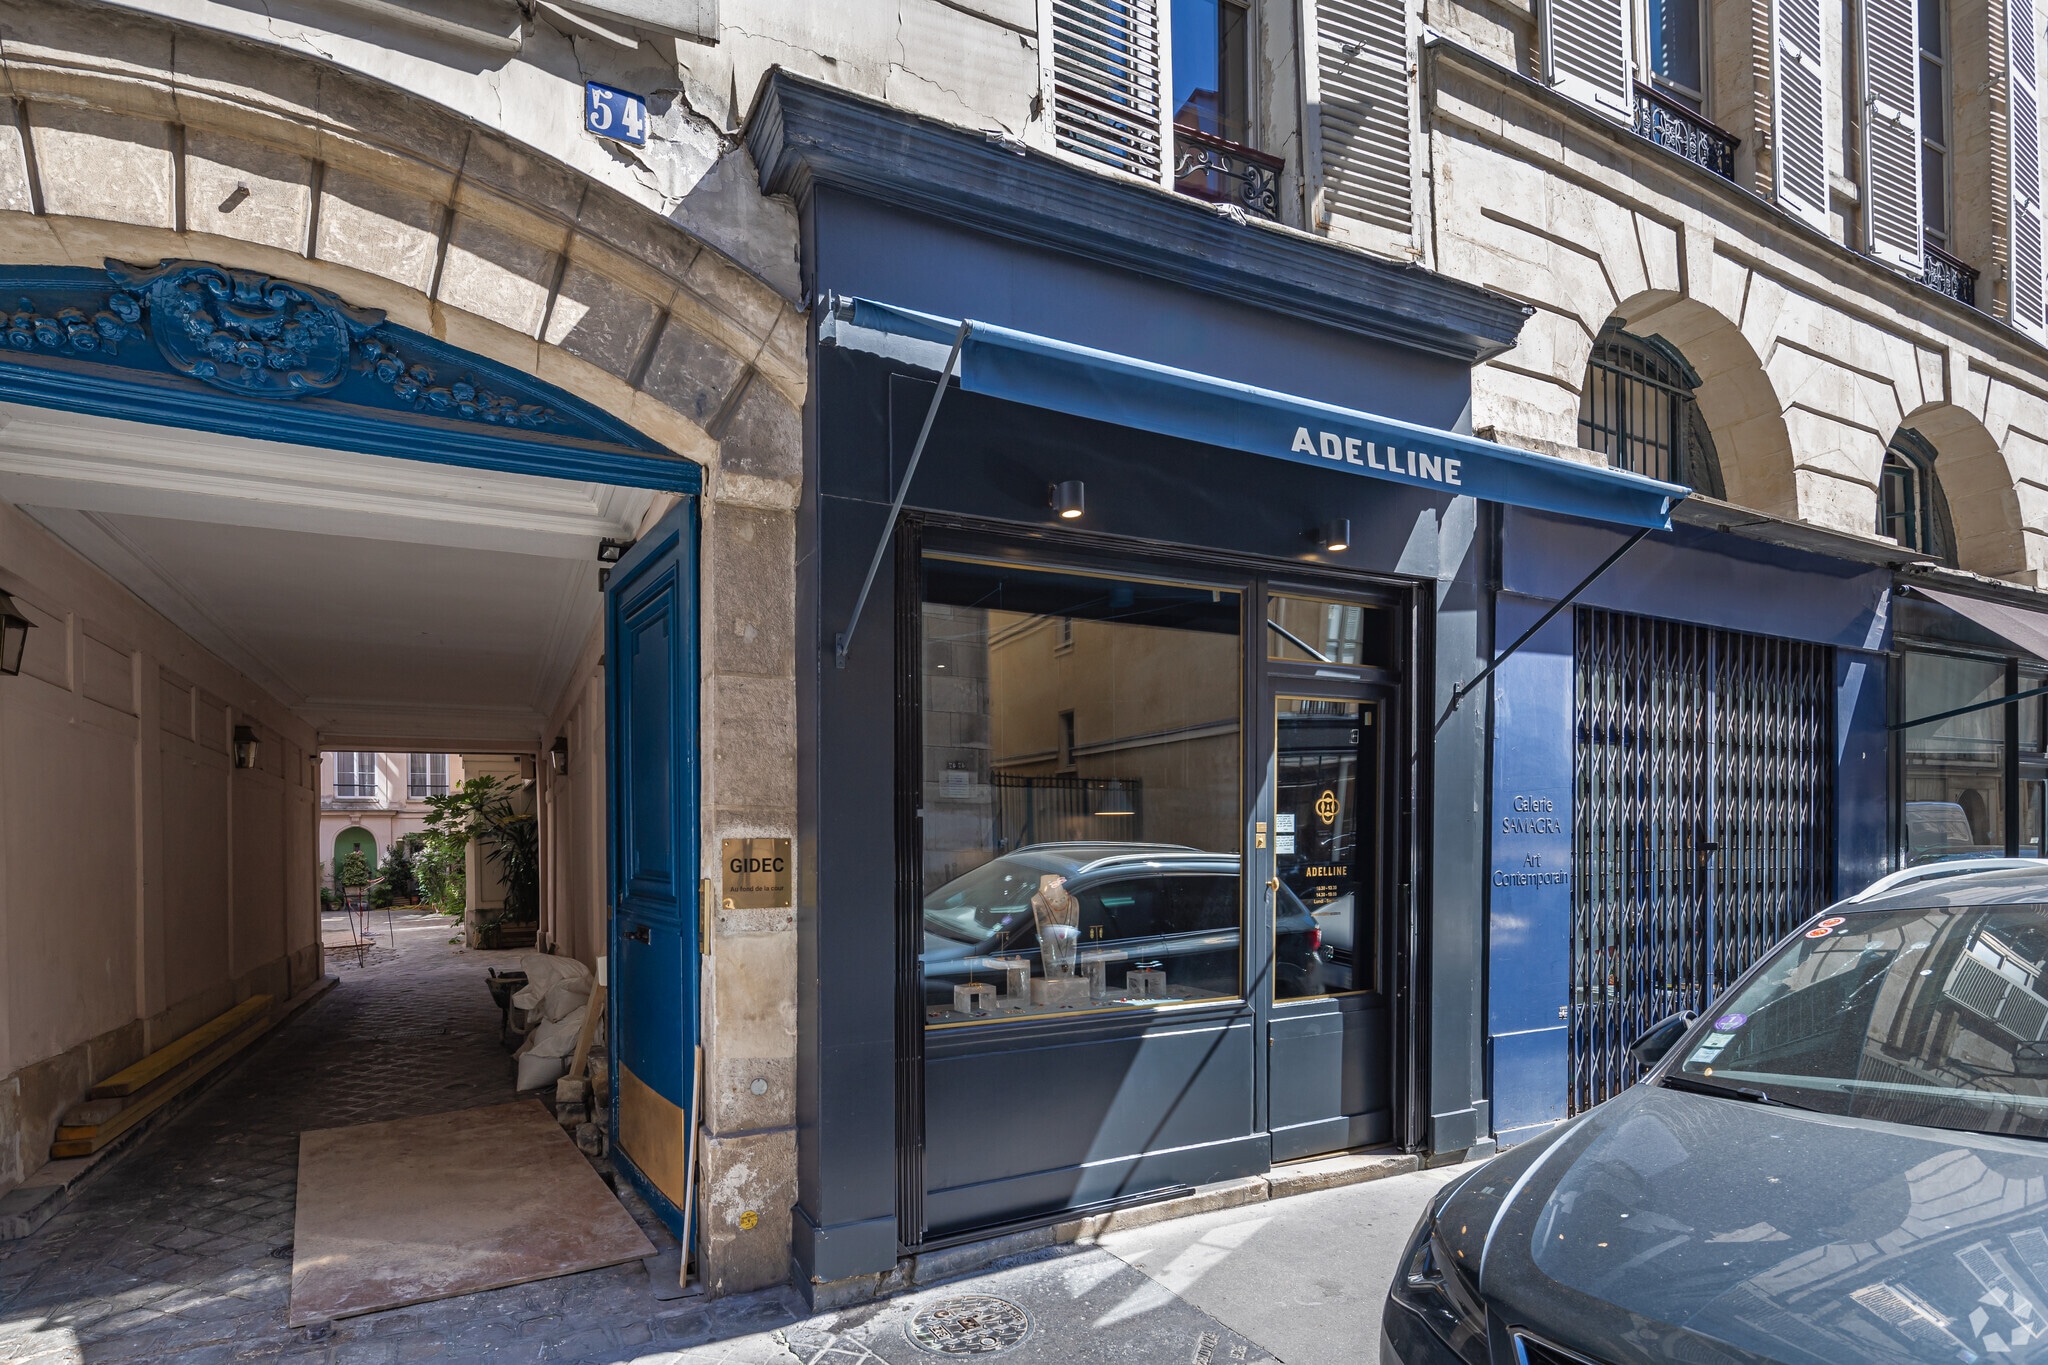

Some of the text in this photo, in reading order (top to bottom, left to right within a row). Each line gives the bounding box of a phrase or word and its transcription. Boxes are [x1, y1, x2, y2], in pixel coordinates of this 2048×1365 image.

[590, 88, 643, 139] 54
[1291, 426, 1462, 486] ADELLINE
[1513, 794, 1553, 812] Galerie
[730, 858, 784, 873] GIDEC
[1523, 852, 1541, 868] Art
[1306, 866, 1347, 877] ADELLINE
[1493, 869, 1568, 890] Contemporain
